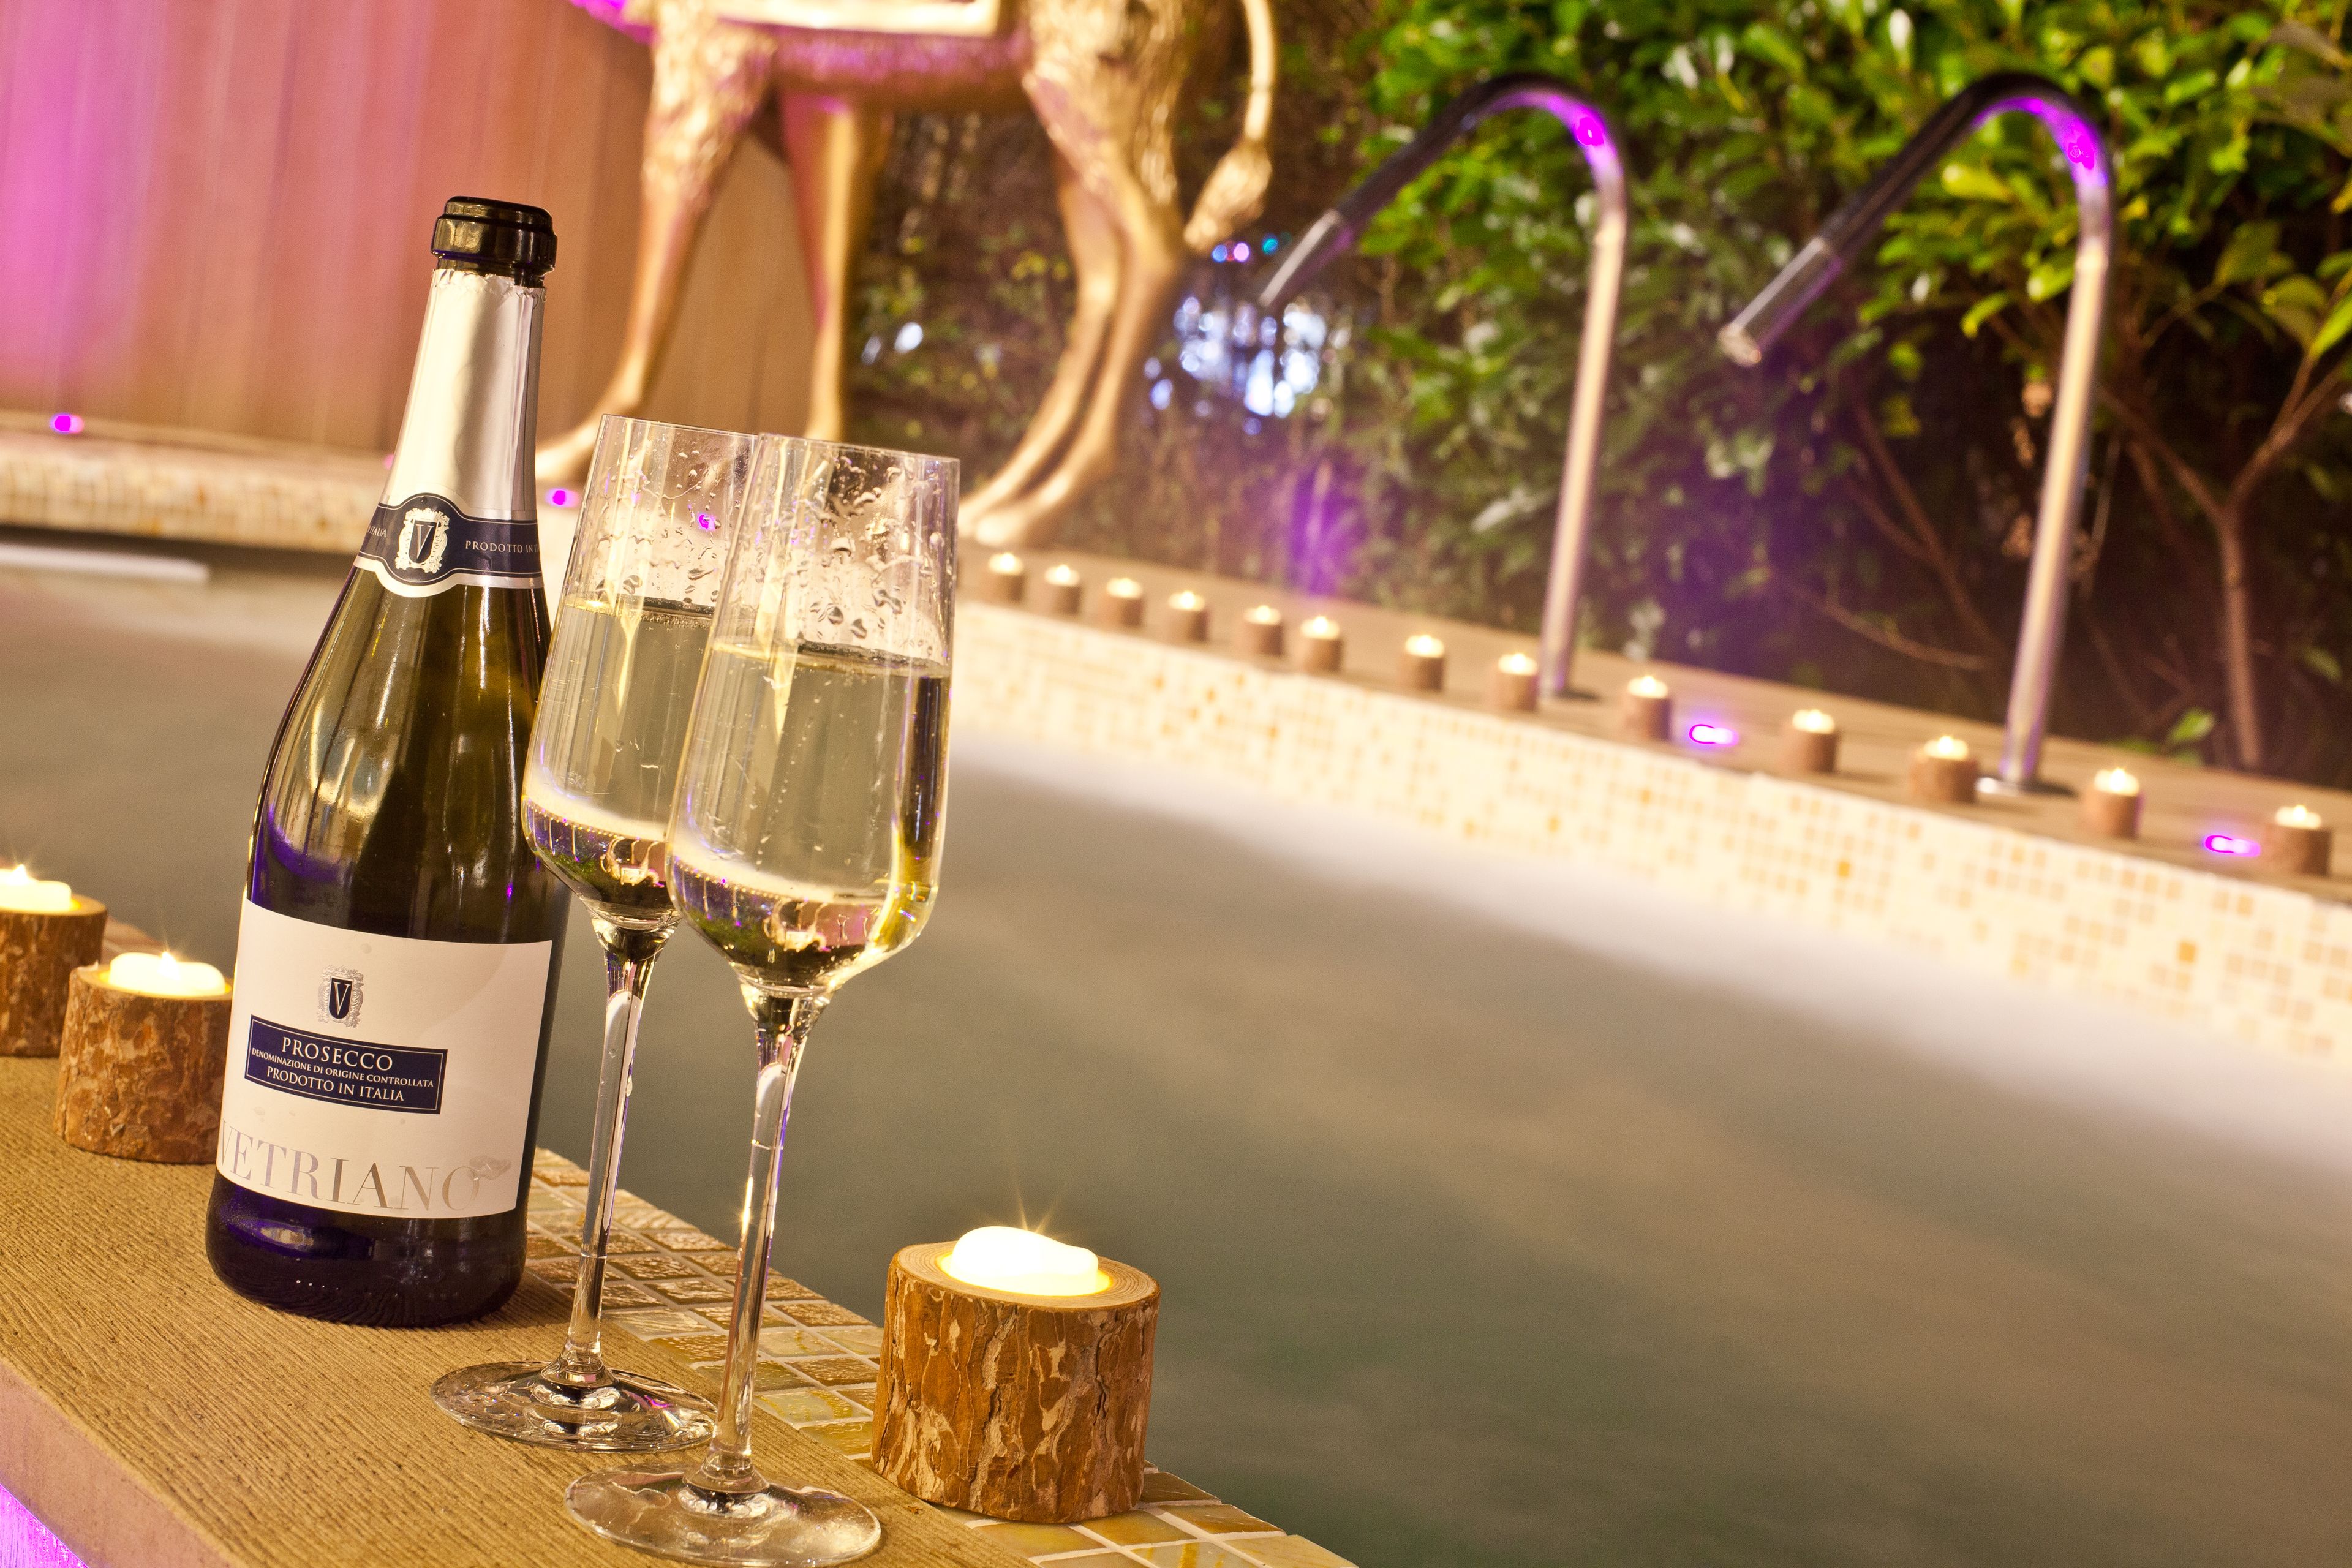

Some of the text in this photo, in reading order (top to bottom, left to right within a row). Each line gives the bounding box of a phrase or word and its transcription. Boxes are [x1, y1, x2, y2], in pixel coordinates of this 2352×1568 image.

[369, 526, 386, 538] ITALIA
[415, 523, 434, 559] V
[466, 540, 523, 553] PRODOTTO
[526, 544, 533, 553] IN
[333, 981, 352, 1016] V
[252, 1047, 434, 1088] DENOMINAZIONE DI ORIGINE CONTROLLATA
[282, 1036, 393, 1071] PROSECCO
[267, 1066, 404, 1102] PRODOTTO IN ITALIA
[222, 1118, 480, 1211] VETRIANO
